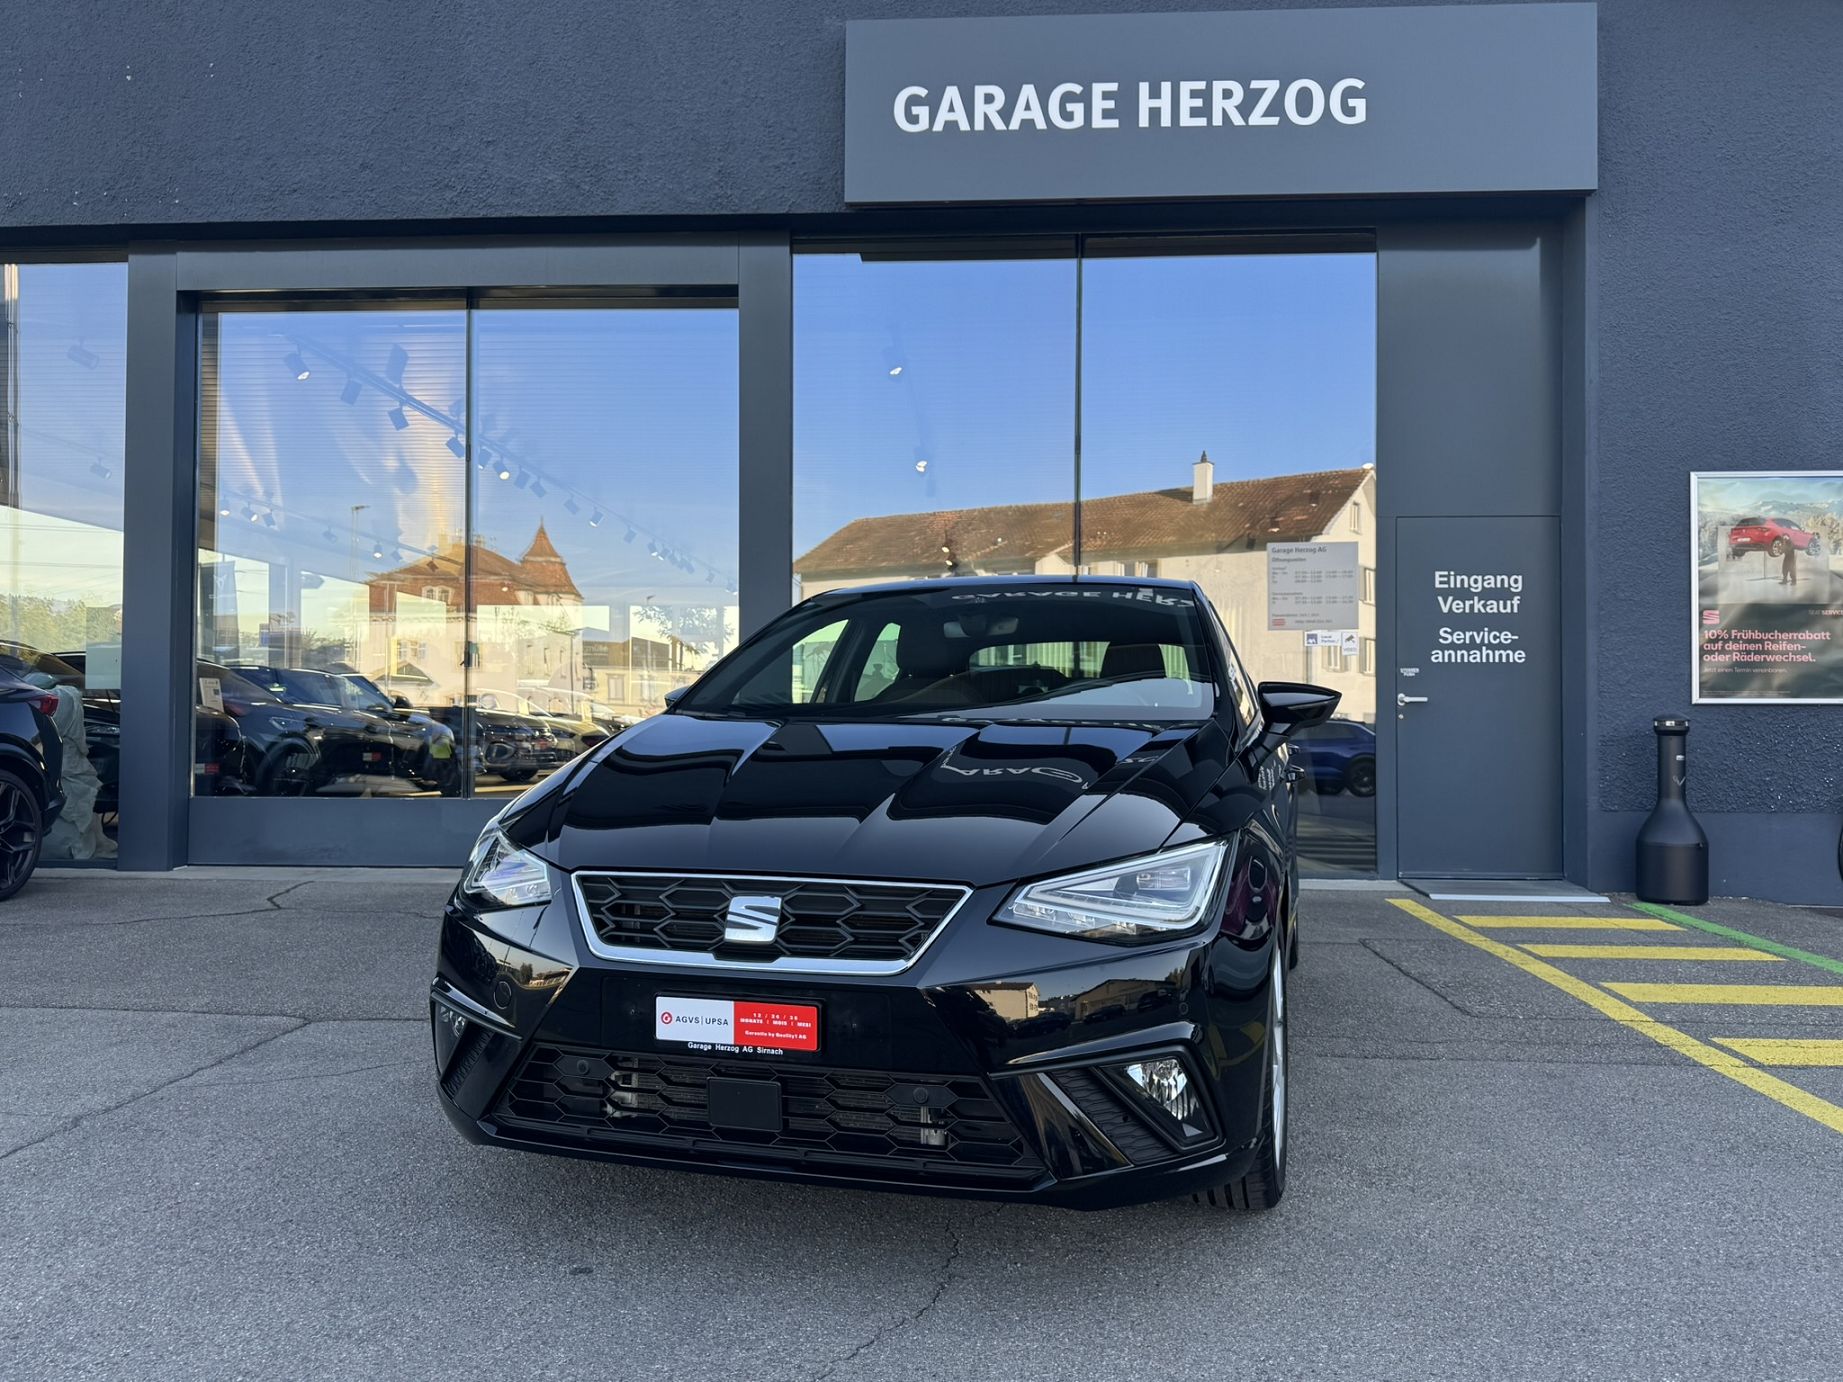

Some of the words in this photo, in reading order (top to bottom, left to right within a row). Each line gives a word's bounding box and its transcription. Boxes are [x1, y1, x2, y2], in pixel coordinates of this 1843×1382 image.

[893, 82, 1119, 132] GARAGE
[1138, 77, 1367, 128] HERZOG
[1295, 546, 1317, 554] Herzog
[1434, 571, 1523, 593] Eingang
[1437, 596, 1521, 613] Verkauf
[1438, 627, 1519, 644] Service-
[1703, 629, 1729, 640] 10%
[1731, 629, 1831, 640] Frühbucherrabatt
[1703, 641, 1723, 650] auf
[1724, 641, 1762, 651] deinen
[1764, 641, 1807, 651] Reifen-
[1430, 646, 1526, 663] annahme
[1703, 652, 1731, 662] oder
[1733, 652, 1816, 662] Räderwechsel.
[705, 1017, 729, 1025] UPSA
[687, 1041, 712, 1051] Garage
[715, 1043, 740, 1053] Herzog
[742, 1045, 754, 1053] AG
[756, 1046, 783, 1055] Sirnach
